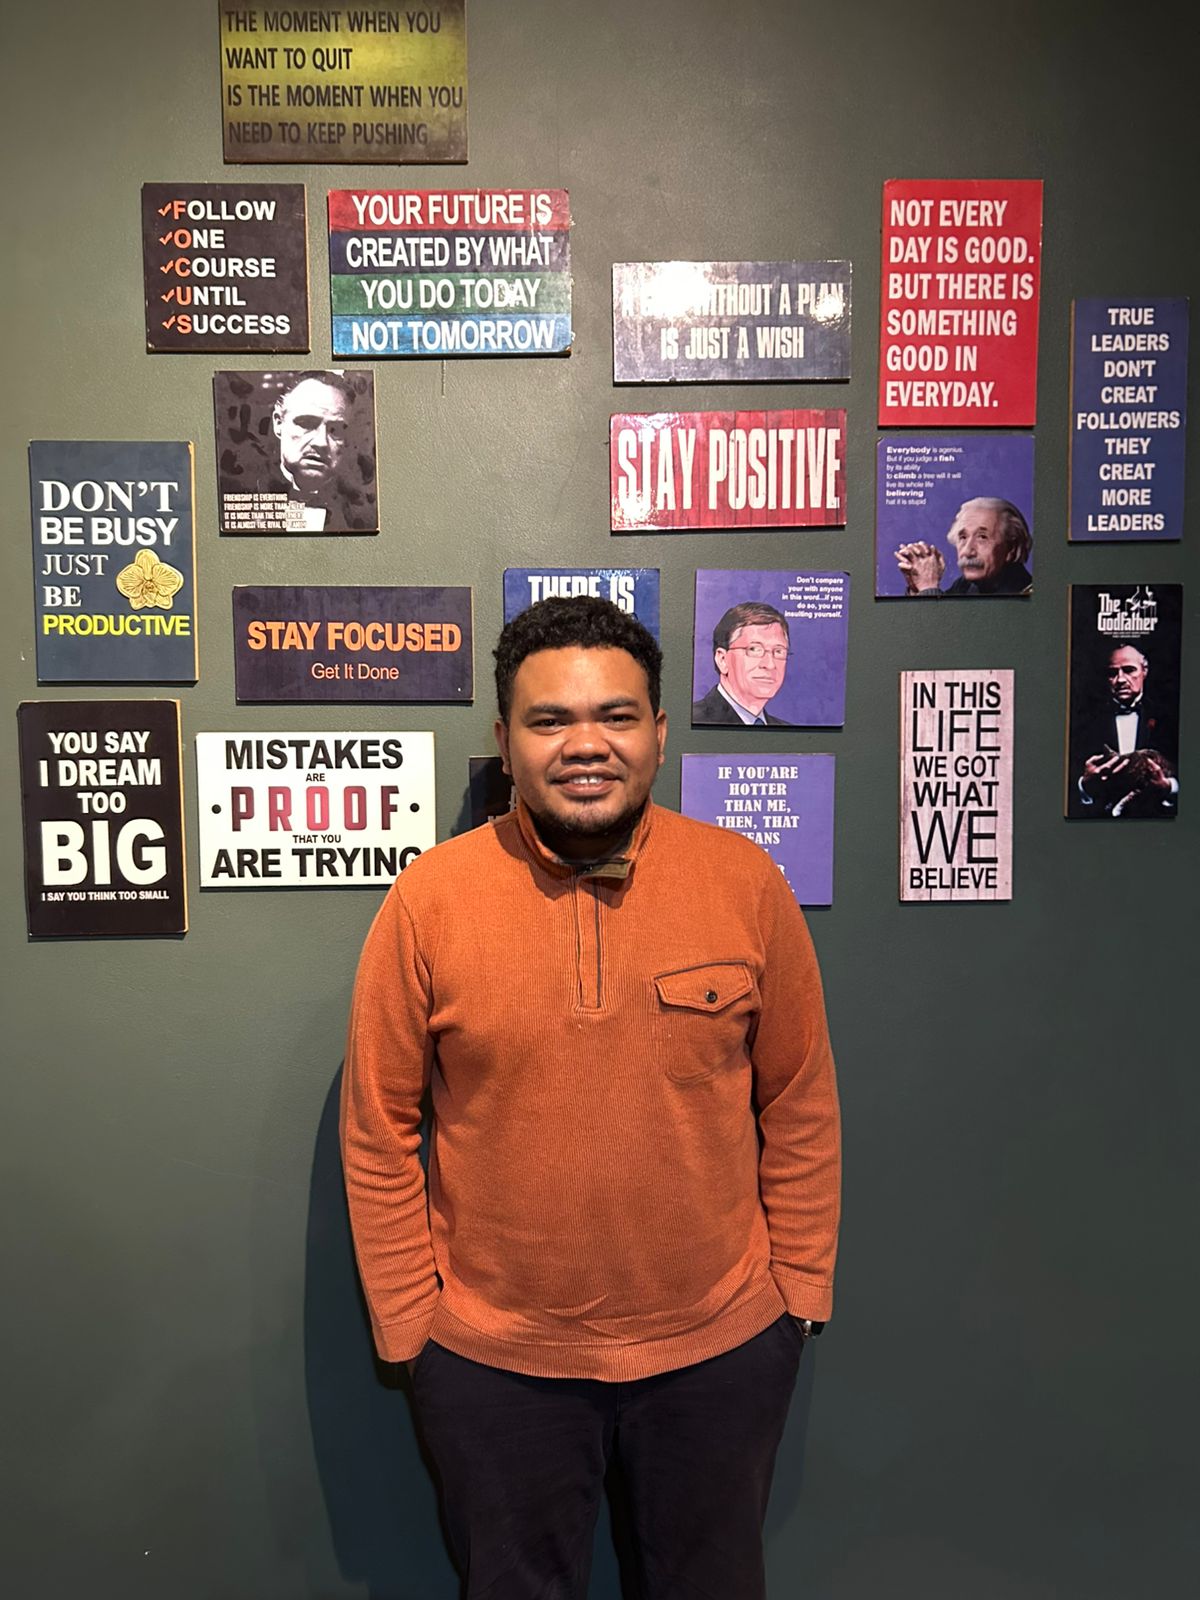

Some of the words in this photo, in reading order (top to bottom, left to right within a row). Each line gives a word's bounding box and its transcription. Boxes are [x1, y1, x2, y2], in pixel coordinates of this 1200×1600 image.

[225, 11, 257, 32] THE
[264, 11, 341, 32] MOMENT
[347, 12, 400, 32] WHEN
[406, 12, 441, 33] YOU
[226, 48, 278, 69] WANT
[283, 48, 306, 69] TO
[312, 48, 353, 72] QUIT
[227, 85, 242, 106] IS
[247, 85, 280, 106] THE
[287, 85, 364, 107] MOMENT
[370, 86, 422, 107] WHEN
[428, 87, 463, 108] YOU
[229, 122, 272, 144] NEED
[278, 123, 300, 144] TO
[307, 123, 346, 144] KEEP
[353, 123, 428, 145] PUSHING
[173, 200, 276, 220] FOLLOW
[352, 195, 423, 225] YOUR
[429, 194, 523, 225] FUTURE
[530, 194, 551, 225] IS
[891, 200, 933, 226] NOT
[940, 200, 1008, 226] EVERY
[174, 229, 225, 249] ONE
[890, 236, 932, 264] DAY
[937, 236, 958, 264] IS
[965, 236, 1034, 264] GOOD.
[346, 237, 450, 268] CREATED
[459, 237, 489, 266] BY
[489, 236, 553, 266] WHAT
[175, 258, 276, 278] COURSE
[176, 287, 246, 306] UNTIL
[361, 280, 413, 309] YOU
[420, 279, 454, 309] DO
[460, 279, 541, 308] TODAY
[888, 273, 932, 299] BUT
[936, 273, 1006, 299] THERE
[1012, 273, 1034, 300] IS
[779, 283, 791, 315] A
[177, 315, 290, 335] SUCCESS
[886, 309, 1017, 336] SOMETHING
[1108, 308, 1154, 325] TRUE
[352, 321, 404, 351] NOT
[408, 320, 555, 350] TOMORROW
[660, 327, 679, 360] IS
[685, 327, 731, 359] JUST
[736, 327, 749, 359] A
[756, 327, 805, 359] WISH
[1092, 333, 1169, 352] LEADERS
[886, 345, 948, 372] GOOD
[955, 345, 977, 371] IN
[1104, 360, 1156, 378] DON'T
[885, 381, 998, 407] EVERYDAY.
[1101, 386, 1157, 404] CREAT
[1077, 411, 1180, 430] FOLLOWERS
[887, 446, 931, 455] Everybody
[1104, 437, 1151, 455] THEY
[618, 427, 696, 510] STAY
[708, 427, 841, 510] POSITIVE
[1099, 463, 1155, 480] CREAT
[39, 480, 178, 513] DON'T
[886, 489, 924, 497] believing
[1102, 488, 1151, 506] MORE
[40, 517, 84, 545] BE
[91, 517, 179, 546] BUSY
[1087, 514, 1164, 531] LEADERS
[42, 554, 108, 576] JUST
[43, 586, 81, 607] BE
[609, 576, 635, 614] IS
[1098, 593, 1121, 612] The
[43, 615, 190, 636] PRODUCTIVE
[1097, 611, 1158, 631] Godfather
[247, 620, 320, 650] STAY
[327, 622, 462, 652] FOCUSED
[311, 662, 340, 679] Get
[344, 663, 354, 679] It
[358, 663, 399, 680] Done
[913, 682, 936, 708] IN
[944, 682, 1001, 708] THIS
[912, 710, 1001, 752] LIFE
[48, 731, 97, 754] YOU
[104, 731, 150, 753] SAY
[225, 739, 403, 770] MISTAKES
[39, 759, 48, 787] I
[58, 758, 161, 786] DREAM
[305, 773, 325, 782] ARE
[718, 766, 732, 779] IF
[737, 766, 798, 779] YOU'ARE
[913, 756, 947, 777] WE
[954, 756, 1000, 777] GOT
[729, 783, 787, 795] HOTTER
[913, 781, 999, 807] WHAT
[77, 791, 126, 814] TOO
[231, 785, 399, 832] PROOF
[724, 800, 762, 812] THAN
[767, 800, 791, 813] ME,
[763, 815, 799, 828] THAT
[292, 835, 318, 844] THAT
[320, 834, 341, 843] YOU
[911, 810, 998, 864] WE
[41, 818, 167, 886] BIG
[211, 848, 282, 878] ARE
[910, 868, 998, 889] BELIEVE
[41, 892, 46, 901] I
[47, 892, 65, 901] SAY
[67, 892, 86, 901] YOU
[88, 891, 117, 900] THINK
[118, 891, 138, 900] TOO
[139, 890, 169, 900] SMALL
